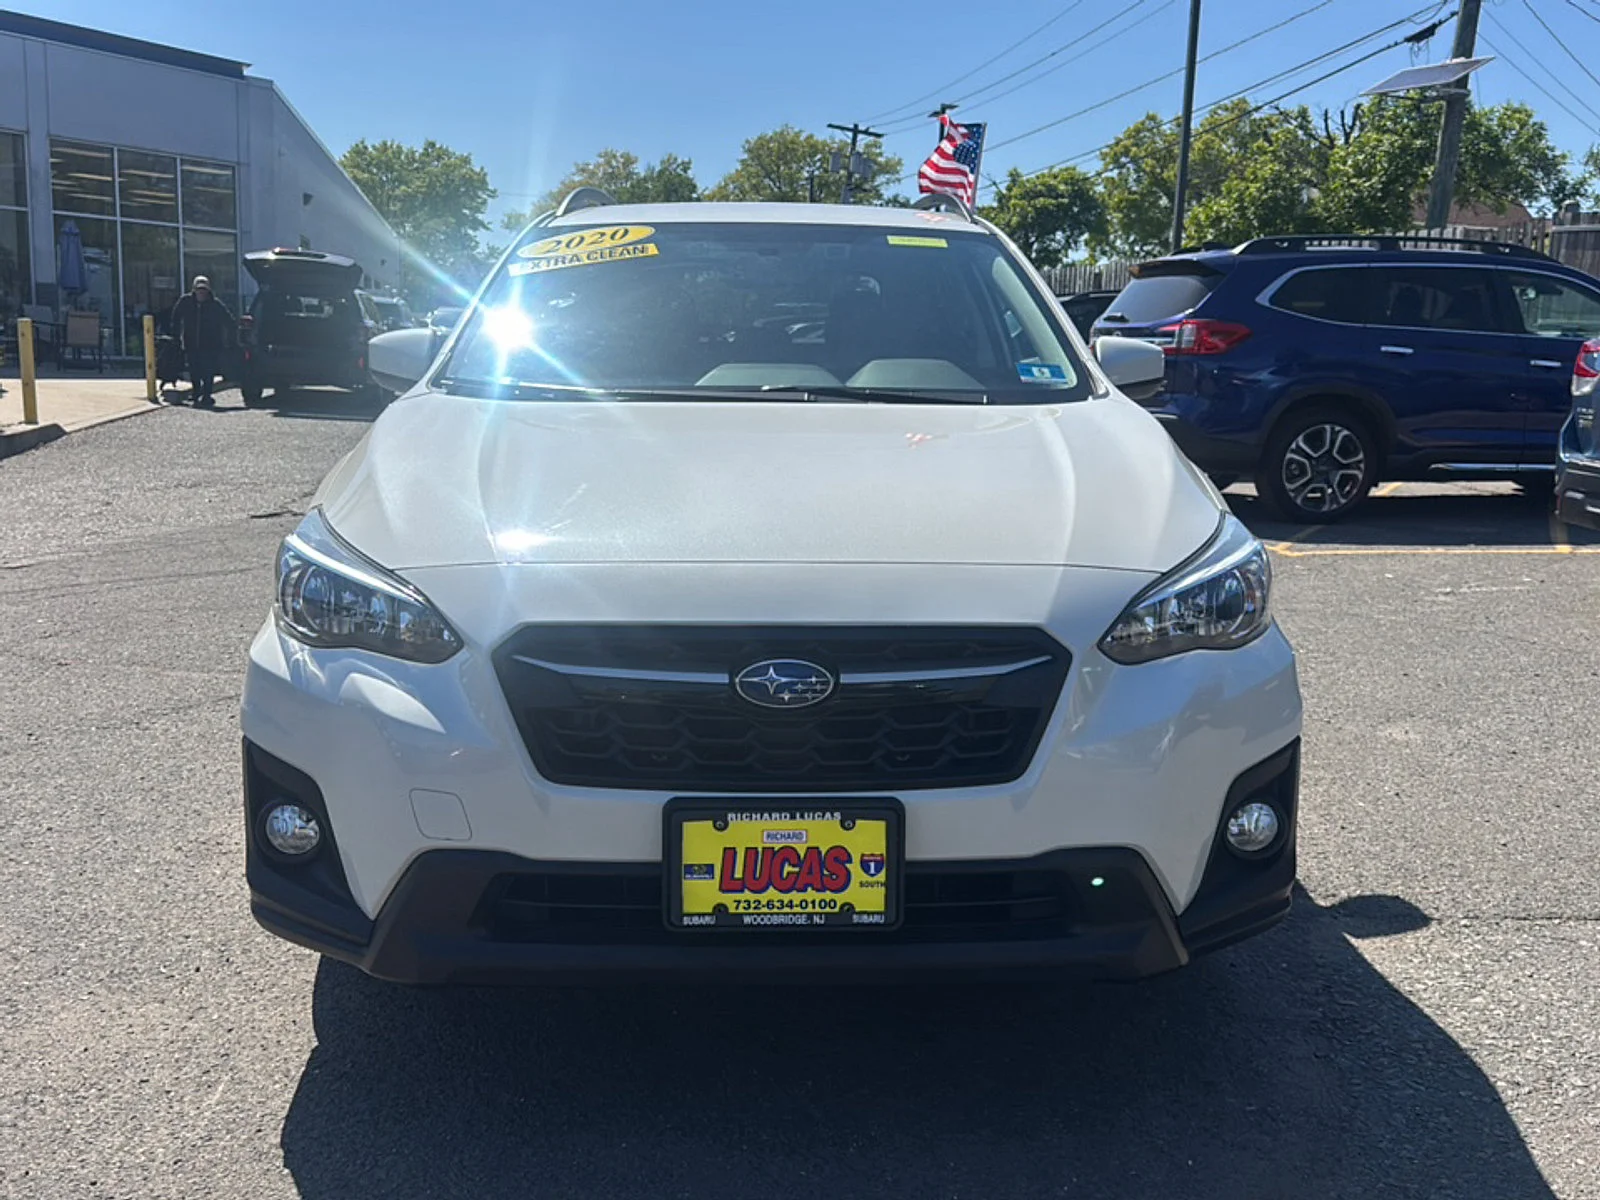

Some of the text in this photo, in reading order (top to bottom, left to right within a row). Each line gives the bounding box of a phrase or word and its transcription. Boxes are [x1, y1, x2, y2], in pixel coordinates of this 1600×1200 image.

[543, 228, 630, 253] 2020
[586, 244, 646, 263] CLEAN
[727, 811, 842, 821] RICHARD LUCAS
[765, 831, 804, 842] RICHARD
[719, 845, 853, 894] LUCAS
[867, 861, 878, 875] 1
[859, 880, 886, 889] SOUTH
[733, 899, 838, 911] 732-634-0100
[683, 915, 716, 925] SUBARU
[813, 913, 826, 925] NJ
[852, 913, 885, 924] SUBARU
